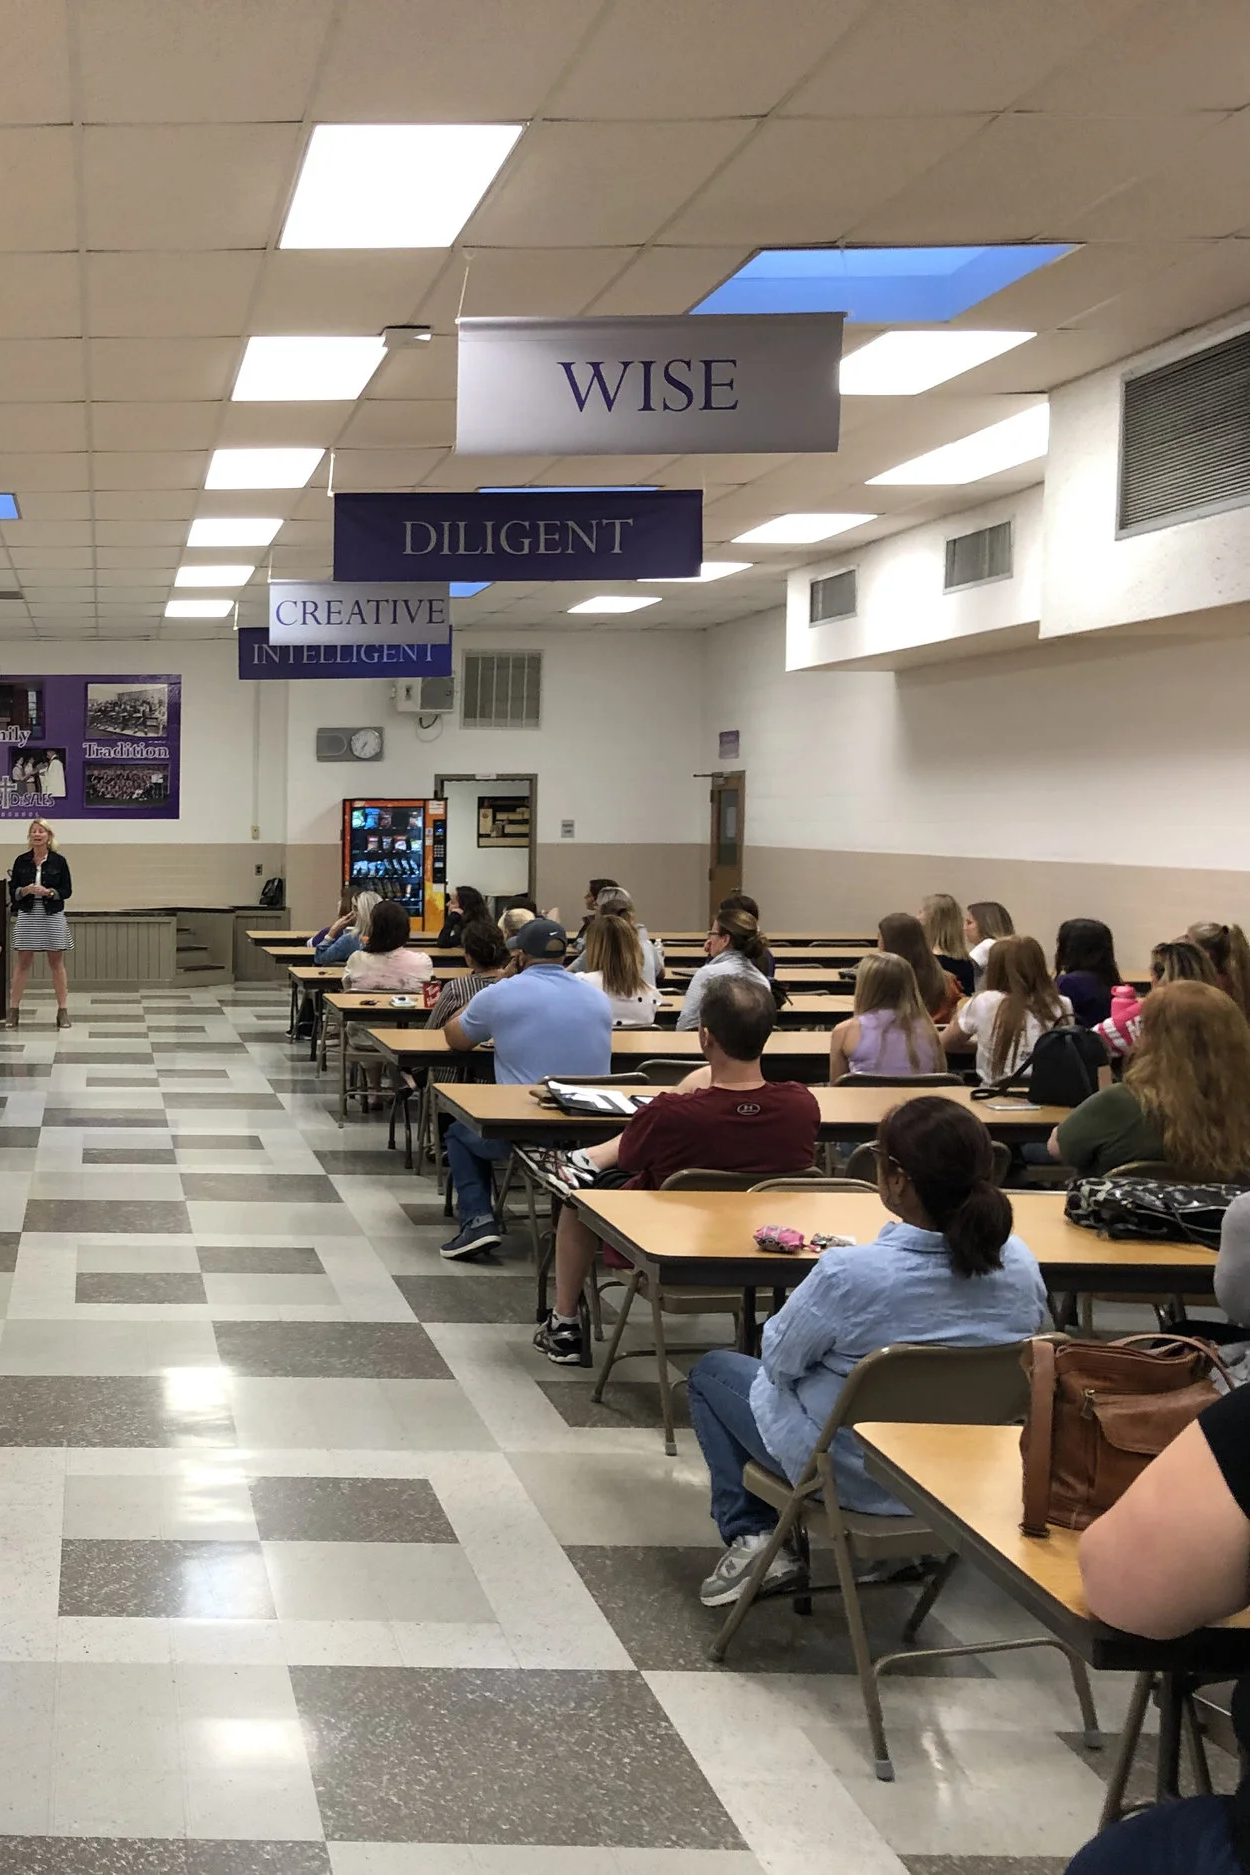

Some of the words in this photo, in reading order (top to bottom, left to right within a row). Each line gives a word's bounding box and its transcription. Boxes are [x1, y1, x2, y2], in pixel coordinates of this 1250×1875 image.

[557, 358, 740, 413] WISE
[402, 518, 634, 556] DILIGENT
[275, 598, 445, 626] CREATIVE
[252, 644, 433, 665] INTELLIGENT
[82, 742, 169, 758] Tradition
